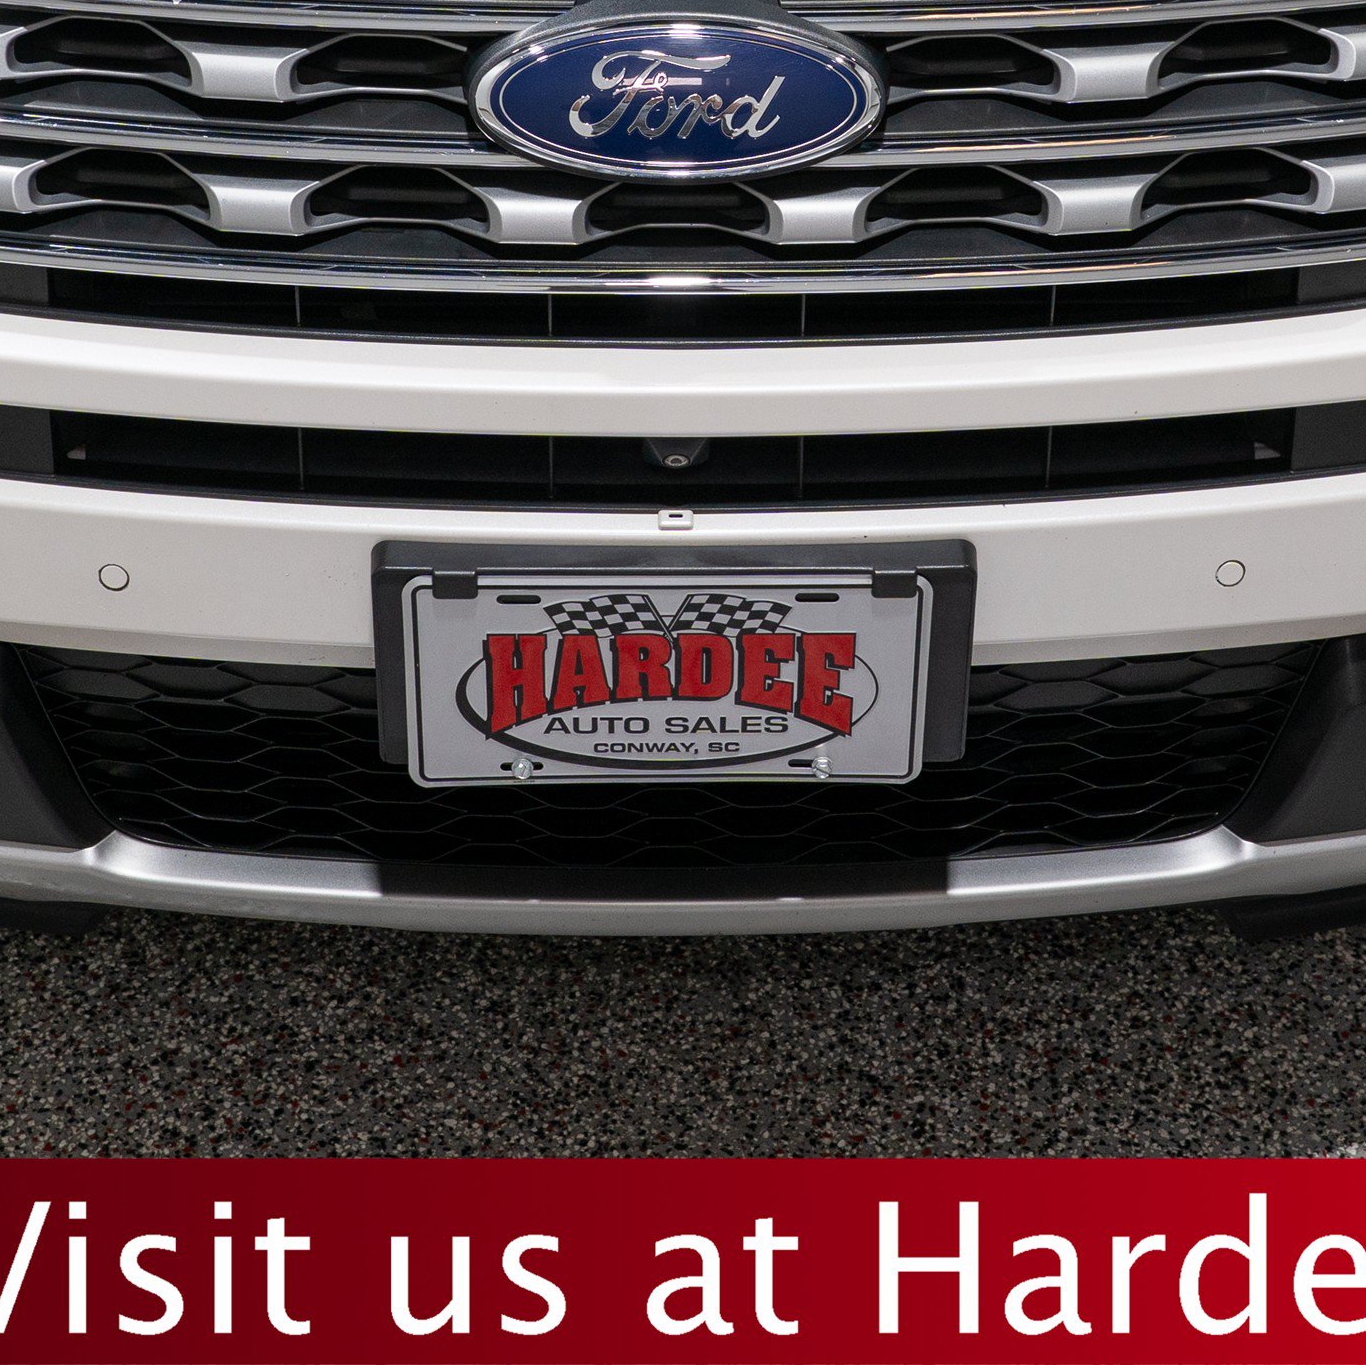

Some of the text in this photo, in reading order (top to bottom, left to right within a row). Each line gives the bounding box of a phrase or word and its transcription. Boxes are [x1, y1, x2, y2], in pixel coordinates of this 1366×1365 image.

[569, 50, 785, 139] Ford
[483, 632, 857, 739] HARDEE
[543, 716, 789, 735] AUTO SALES
[593, 741, 740, 755] CONWAY, SC
